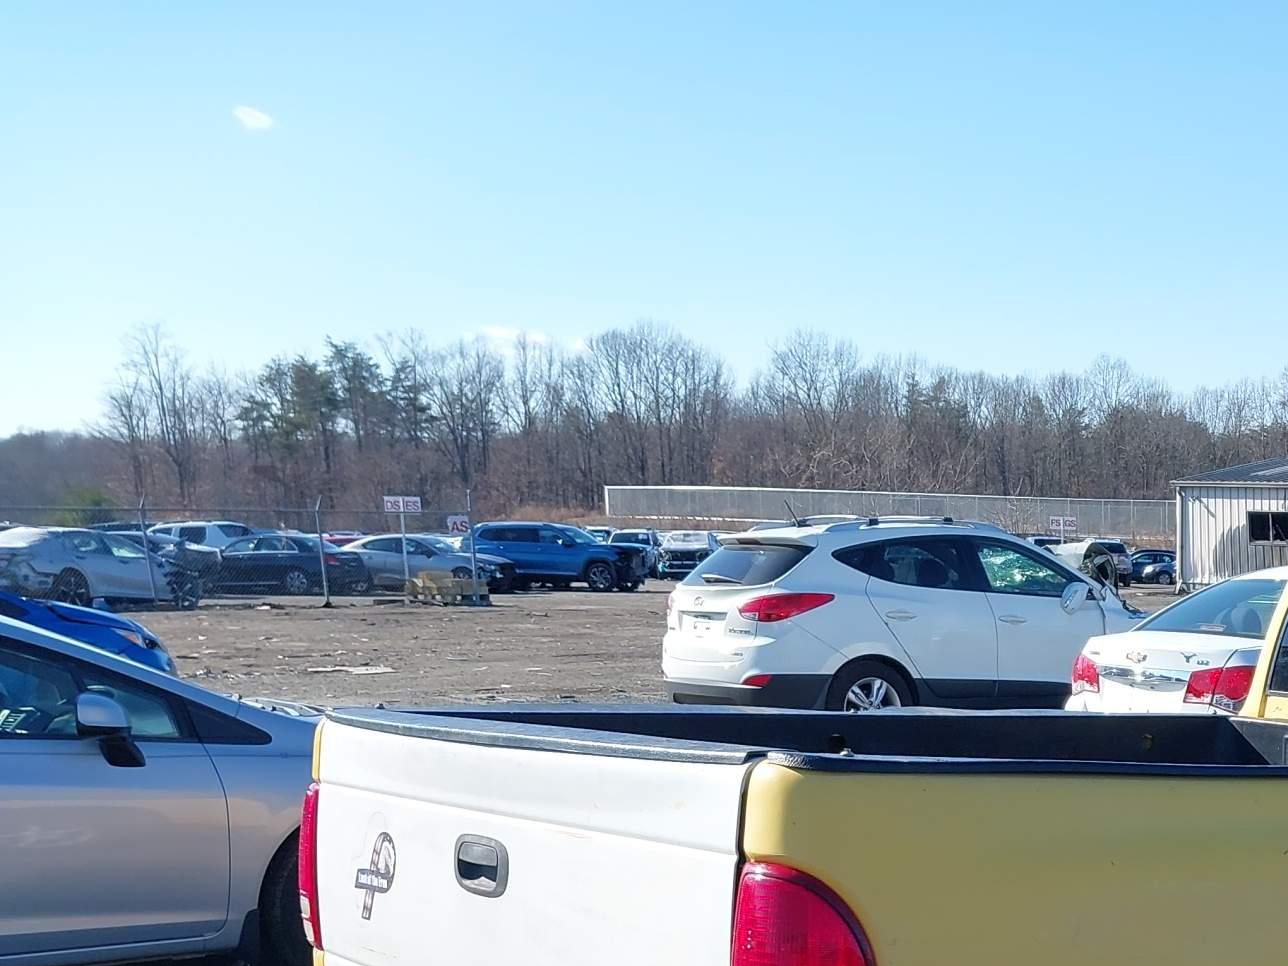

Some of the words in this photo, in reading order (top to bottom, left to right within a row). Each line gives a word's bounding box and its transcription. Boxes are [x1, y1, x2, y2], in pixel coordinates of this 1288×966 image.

[385, 500, 401, 511] DS
[405, 500, 420, 511] ES
[451, 520, 468, 533] AS
[1064, 519, 1076, 528] GS
